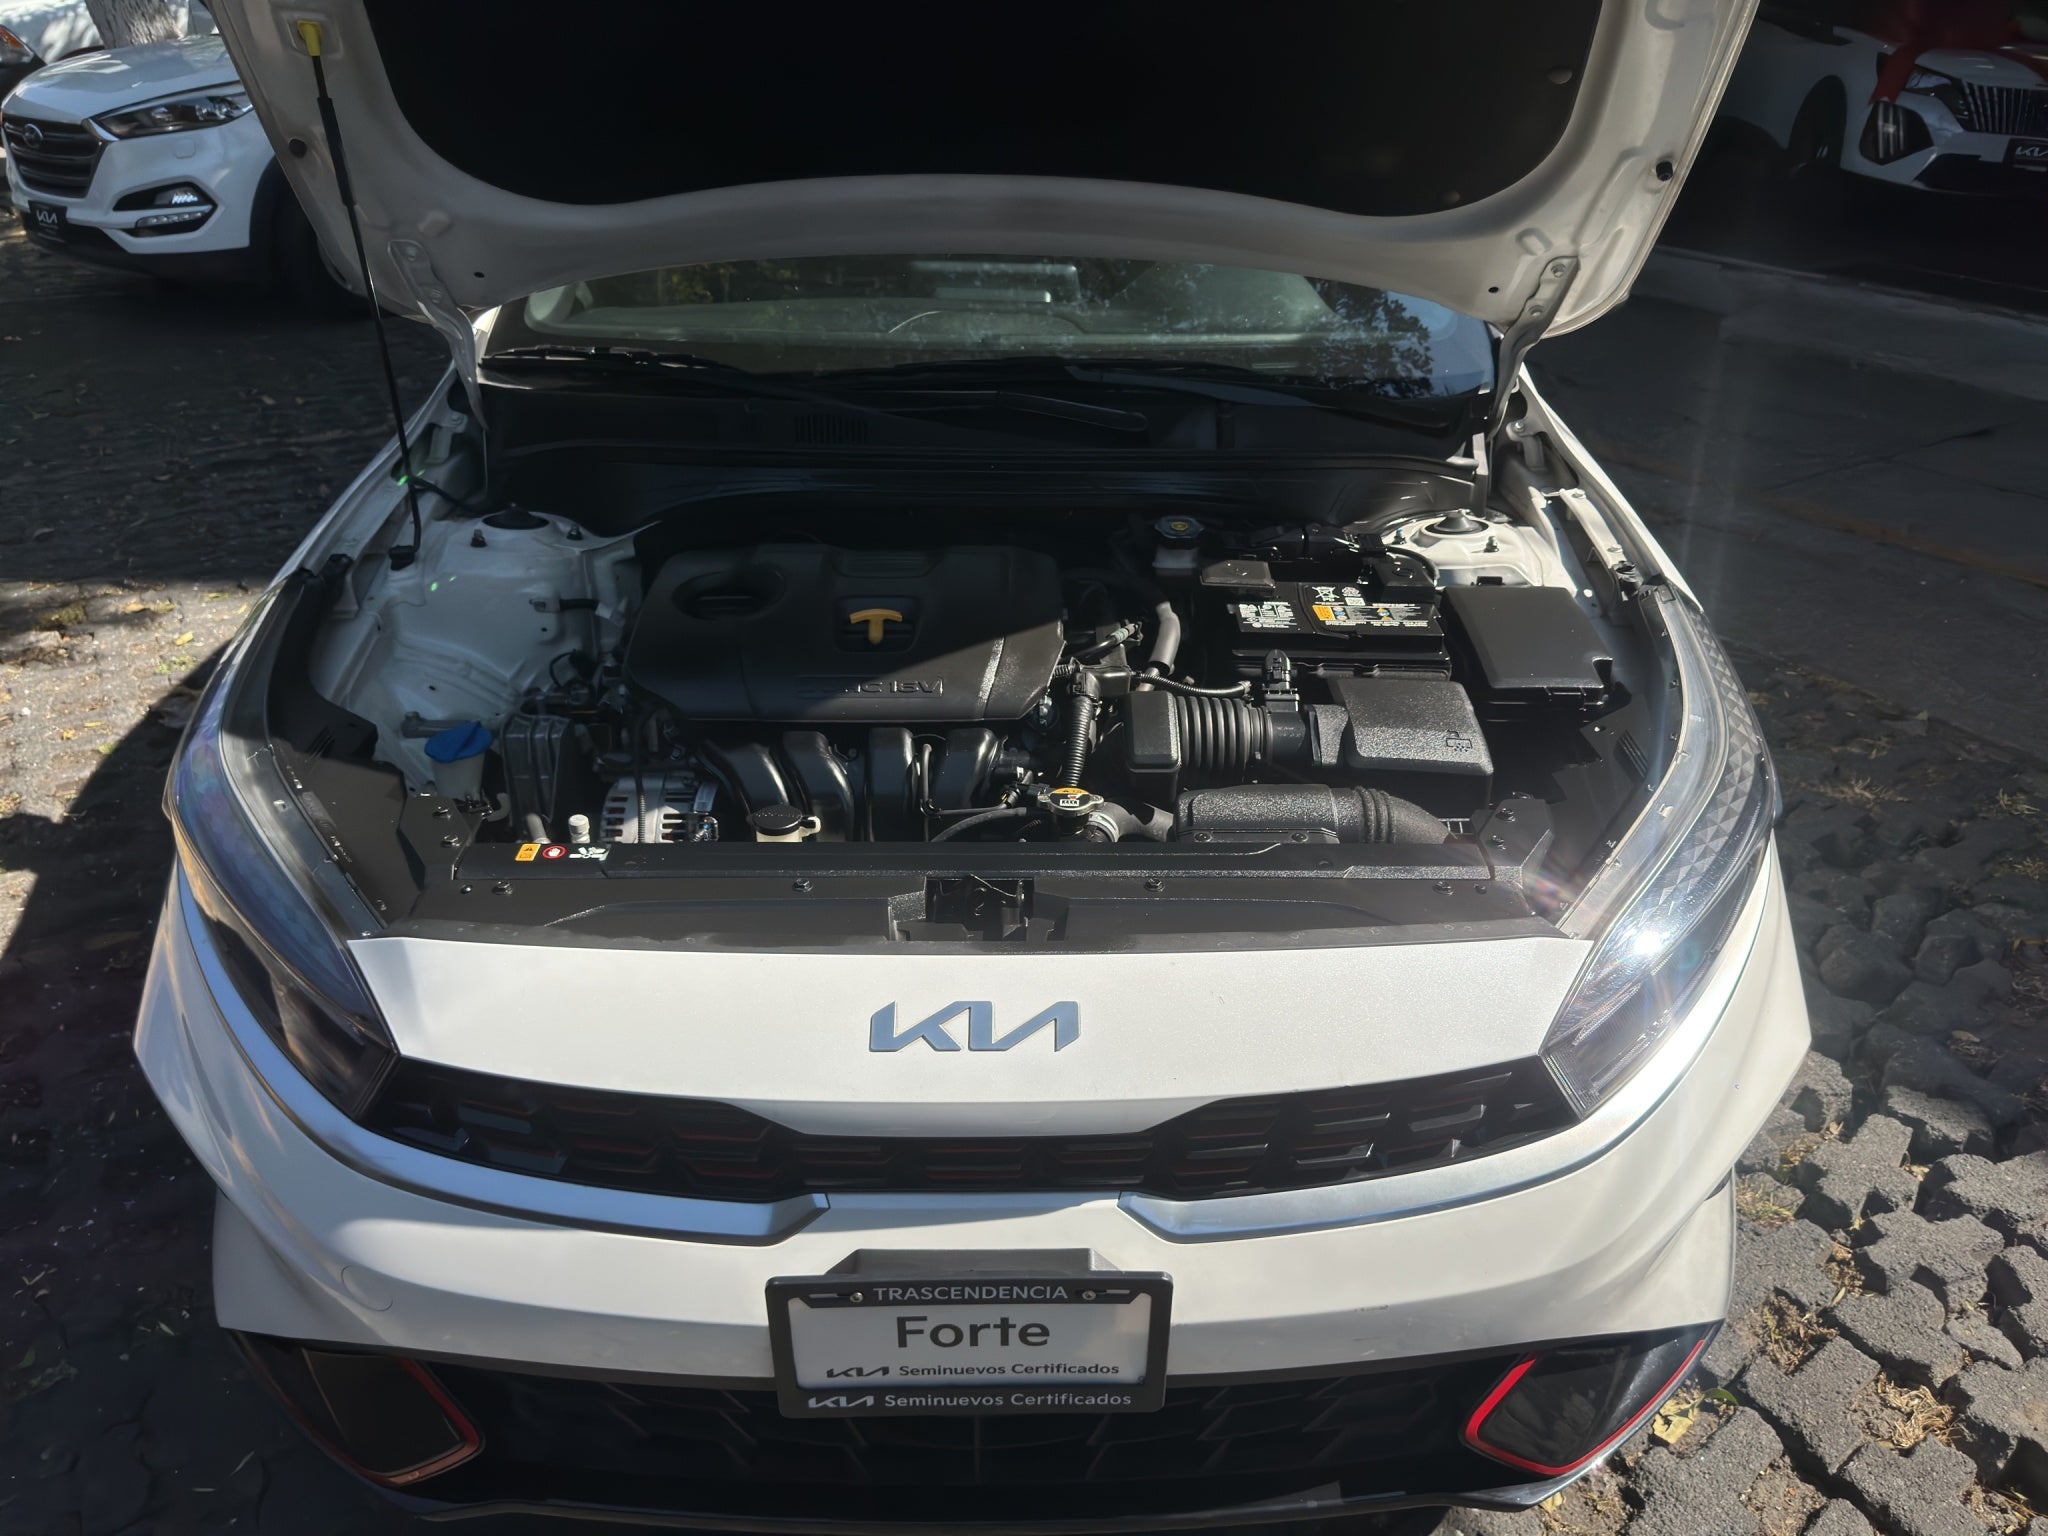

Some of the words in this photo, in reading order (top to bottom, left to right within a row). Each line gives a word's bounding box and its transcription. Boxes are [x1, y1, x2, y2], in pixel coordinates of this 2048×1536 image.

[869, 1000, 1081, 1052] KIA
[873, 1285, 1068, 1301] TRASCENDENCIA
[896, 1315, 1051, 1349] Forte
[826, 1365, 890, 1379] KIA
[899, 1364, 1006, 1377] Seminuevos
[1012, 1363, 1120, 1376] Certificados
[807, 1395, 875, 1409] KIA
[885, 1394, 1004, 1408] Seminuevos
[1010, 1392, 1132, 1406] Certificados
